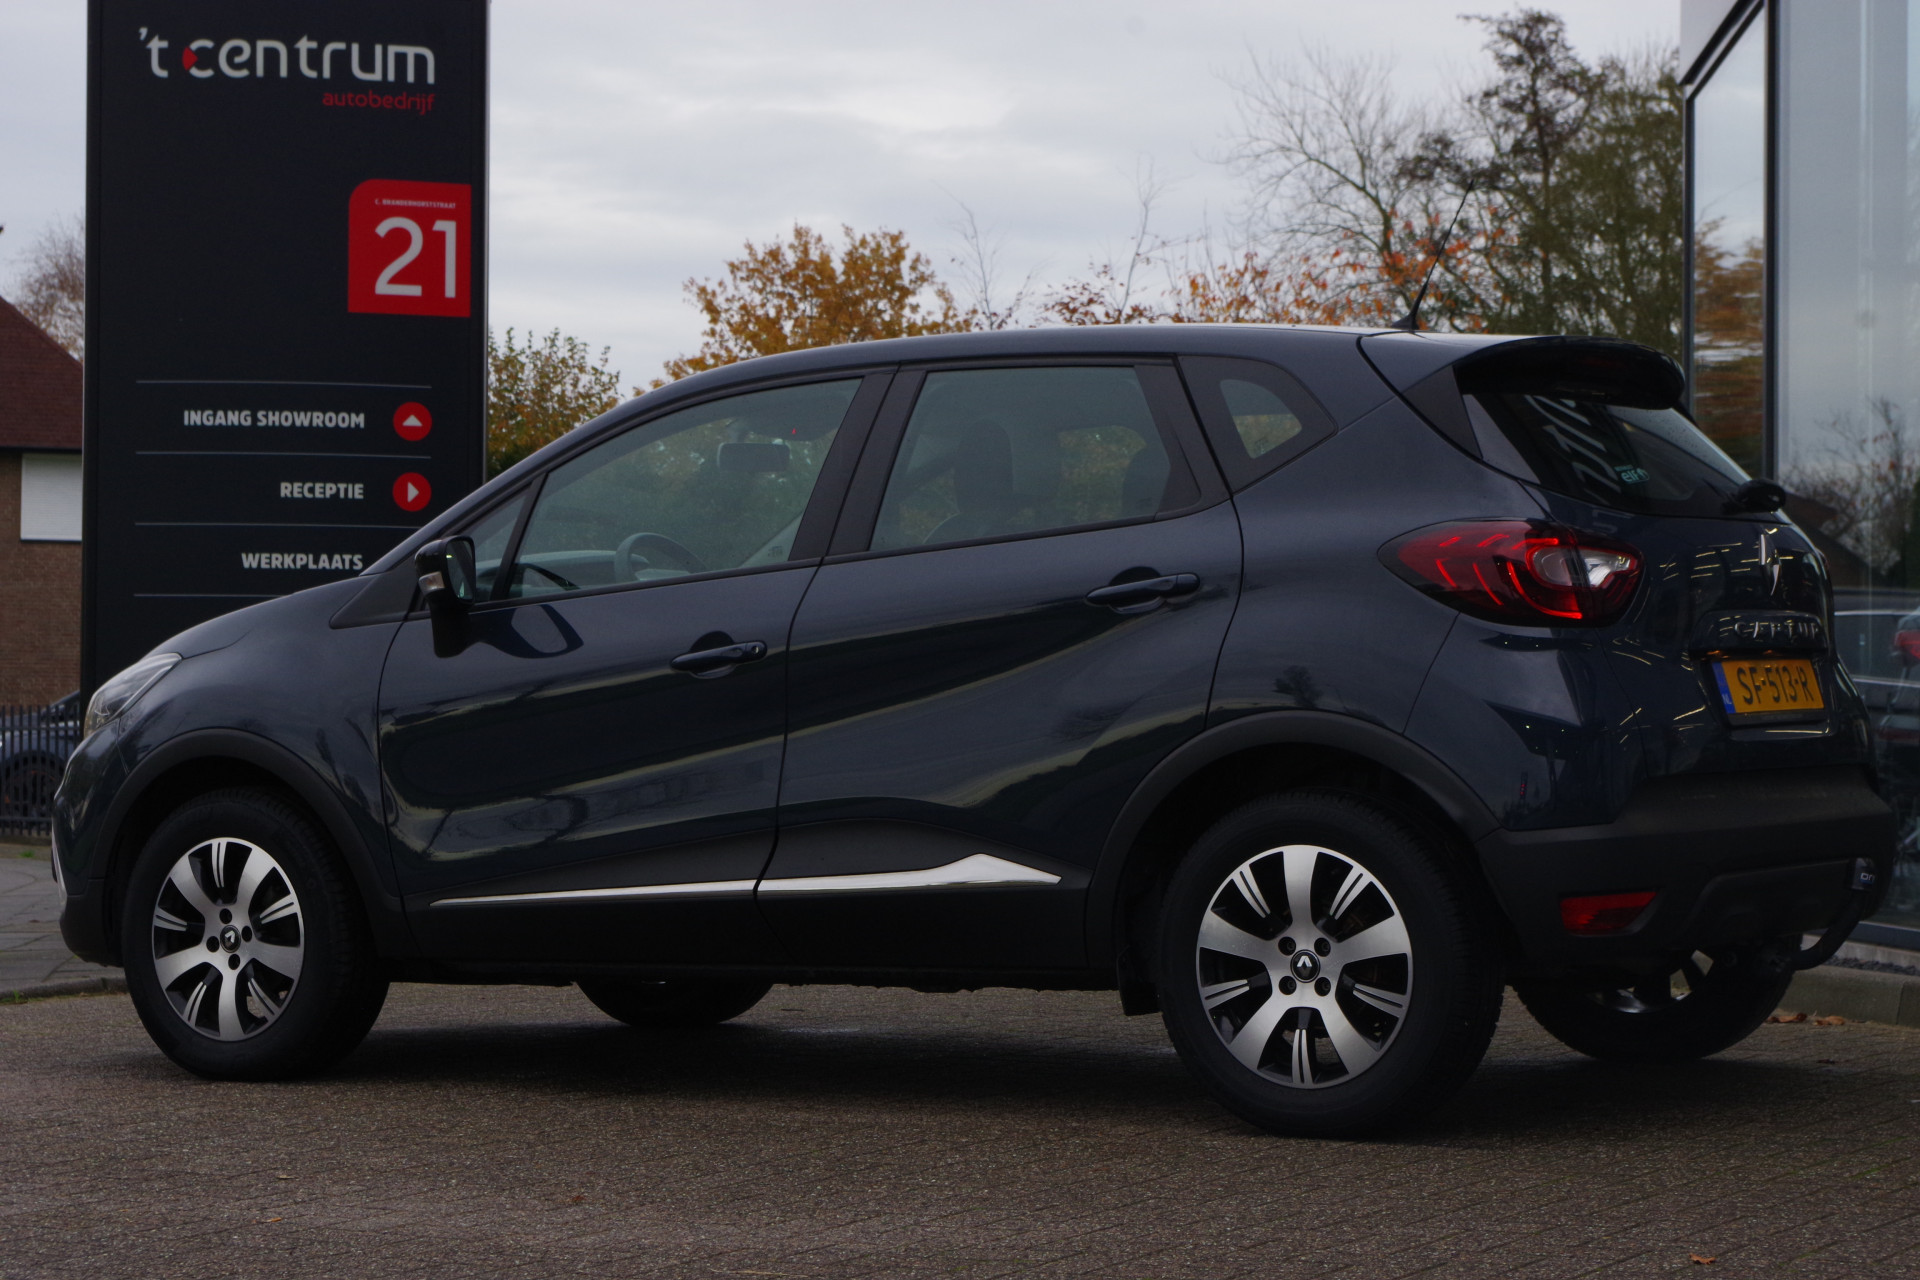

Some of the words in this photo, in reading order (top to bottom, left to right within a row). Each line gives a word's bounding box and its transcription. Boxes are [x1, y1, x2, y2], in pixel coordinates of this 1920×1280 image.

[182, 36, 435, 84] centrum
[322, 91, 436, 115] autobedrijf
[374, 217, 457, 299] 21
[184, 410, 252, 427] INGANG
[256, 411, 365, 429] SHOWROOM
[280, 482, 364, 499] RECEPTIE
[241, 553, 363, 570] WERKPLAATS
[1736, 666, 1815, 706] SF-513-R
